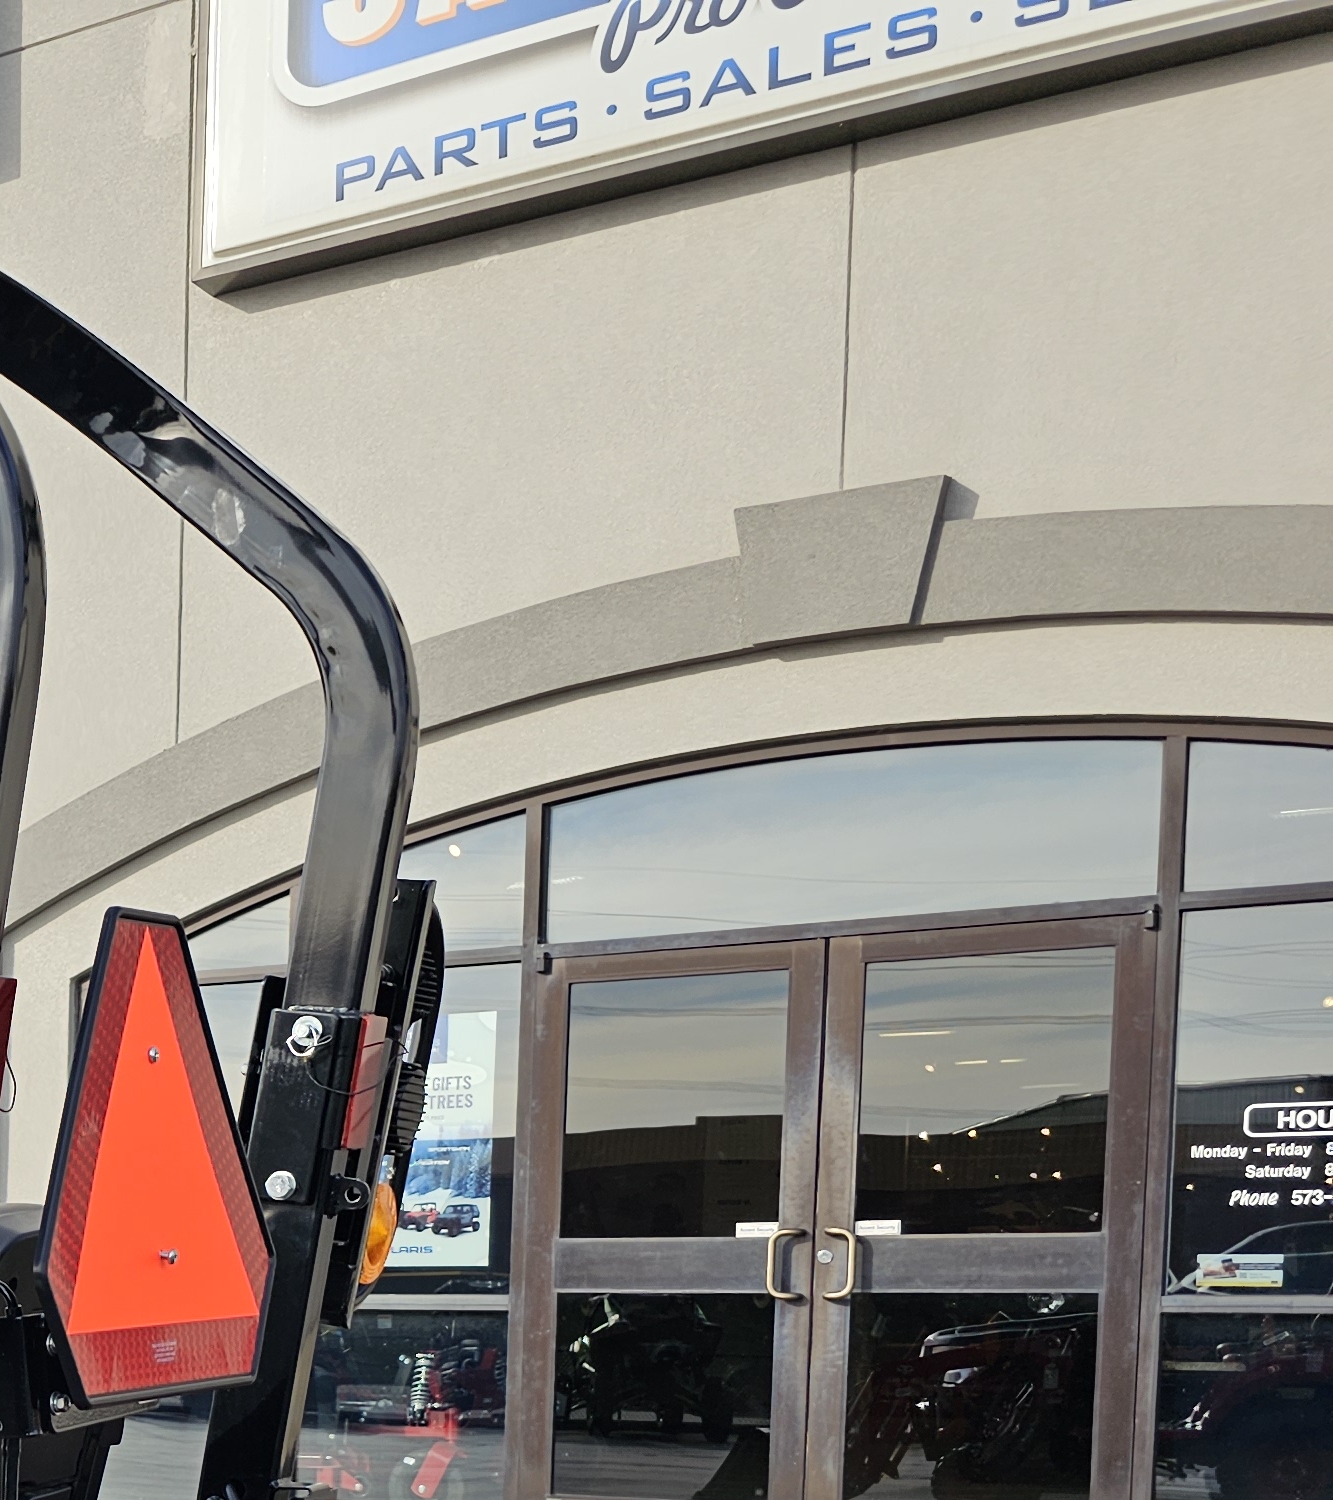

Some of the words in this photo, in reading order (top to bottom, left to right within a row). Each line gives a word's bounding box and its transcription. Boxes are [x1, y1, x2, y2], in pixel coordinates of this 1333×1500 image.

[336, 100, 578, 202] PARTS
[644, 7, 938, 121] SALES
[432, 1075, 472, 1091] GIFTS
[429, 1094, 473, 1109] TREES
[1277, 1109, 1333, 1129] HOU
[1191, 1145, 1248, 1159] Monday
[1267, 1143, 1312, 1158] Friday
[1245, 1164, 1311, 1179] Saturday
[1229, 1189, 1279, 1207] Phone
[391, 1245, 433, 1254] LARIS
